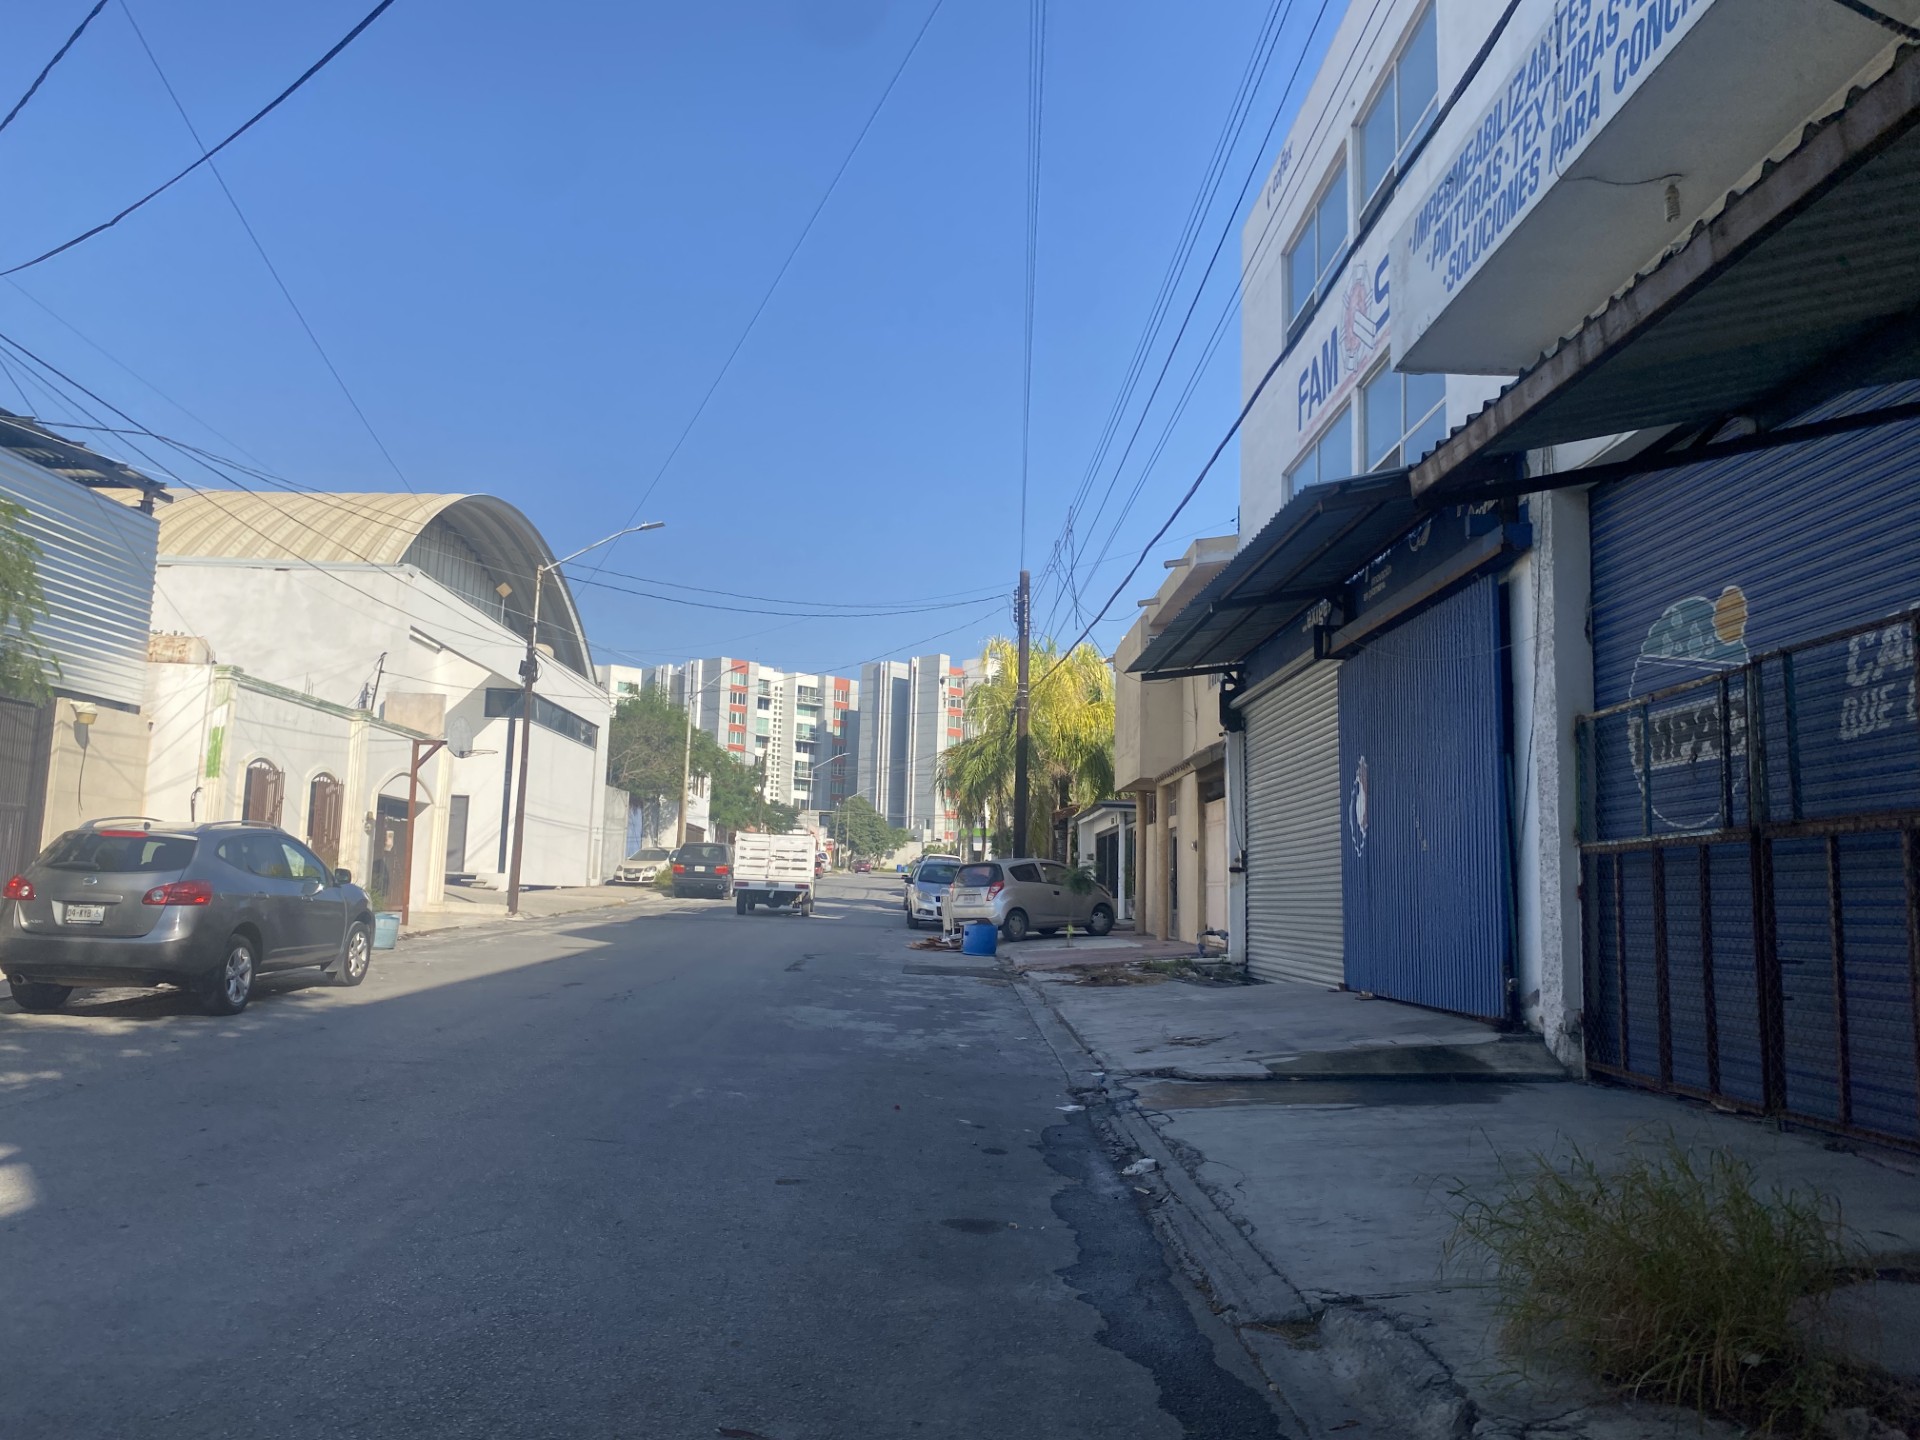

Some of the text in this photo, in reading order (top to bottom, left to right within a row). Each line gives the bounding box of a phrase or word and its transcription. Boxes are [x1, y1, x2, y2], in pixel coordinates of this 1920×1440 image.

[1412, 0, 1591, 255] IMPERMEABILIZANTES
[1431, 1, 1620, 272] PINTURAS TEXTURAS
[1447, 147, 1541, 292] SOLUCIONES
[1548, 71, 1600, 175] PARA
